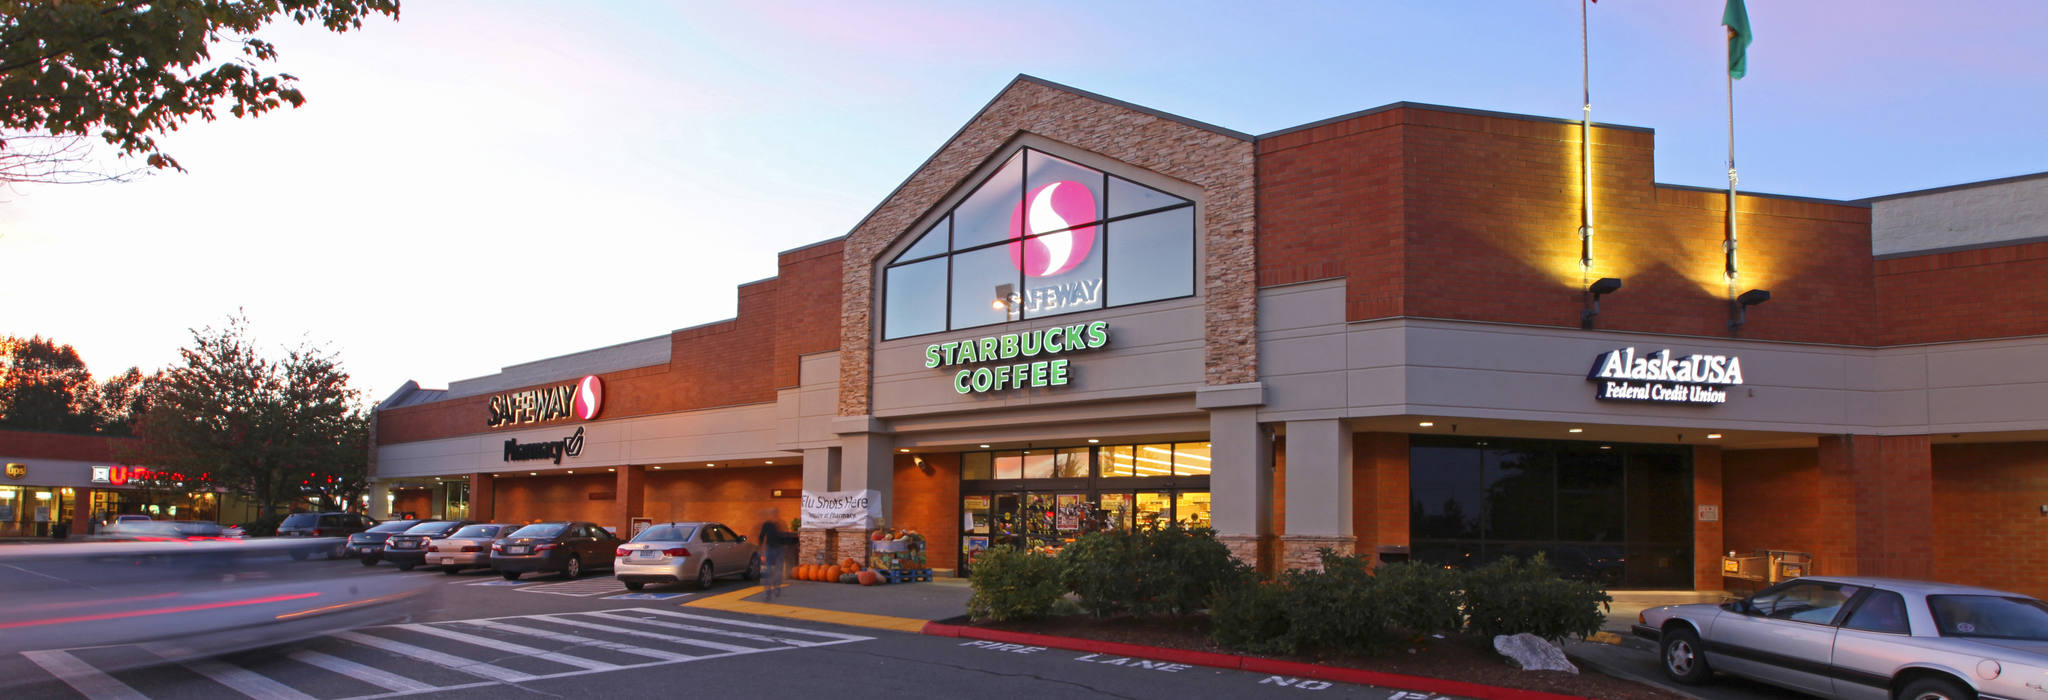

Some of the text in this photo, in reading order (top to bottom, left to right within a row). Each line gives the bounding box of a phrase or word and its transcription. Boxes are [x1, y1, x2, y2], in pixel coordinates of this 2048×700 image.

[925, 320, 1107, 368] STARBUCKS
[954, 359, 1068, 394] COFFEE
[1600, 347, 1744, 385] AlaskaUSA
[488, 384, 578, 428] SAFEWAY
[1605, 381, 1727, 403] Federal Credit Union
[503, 438, 564, 465] Pharmacy
[801, 495, 869, 510] Flu Shots Here
[958, 639, 1334, 691] FIRE LANE NO
